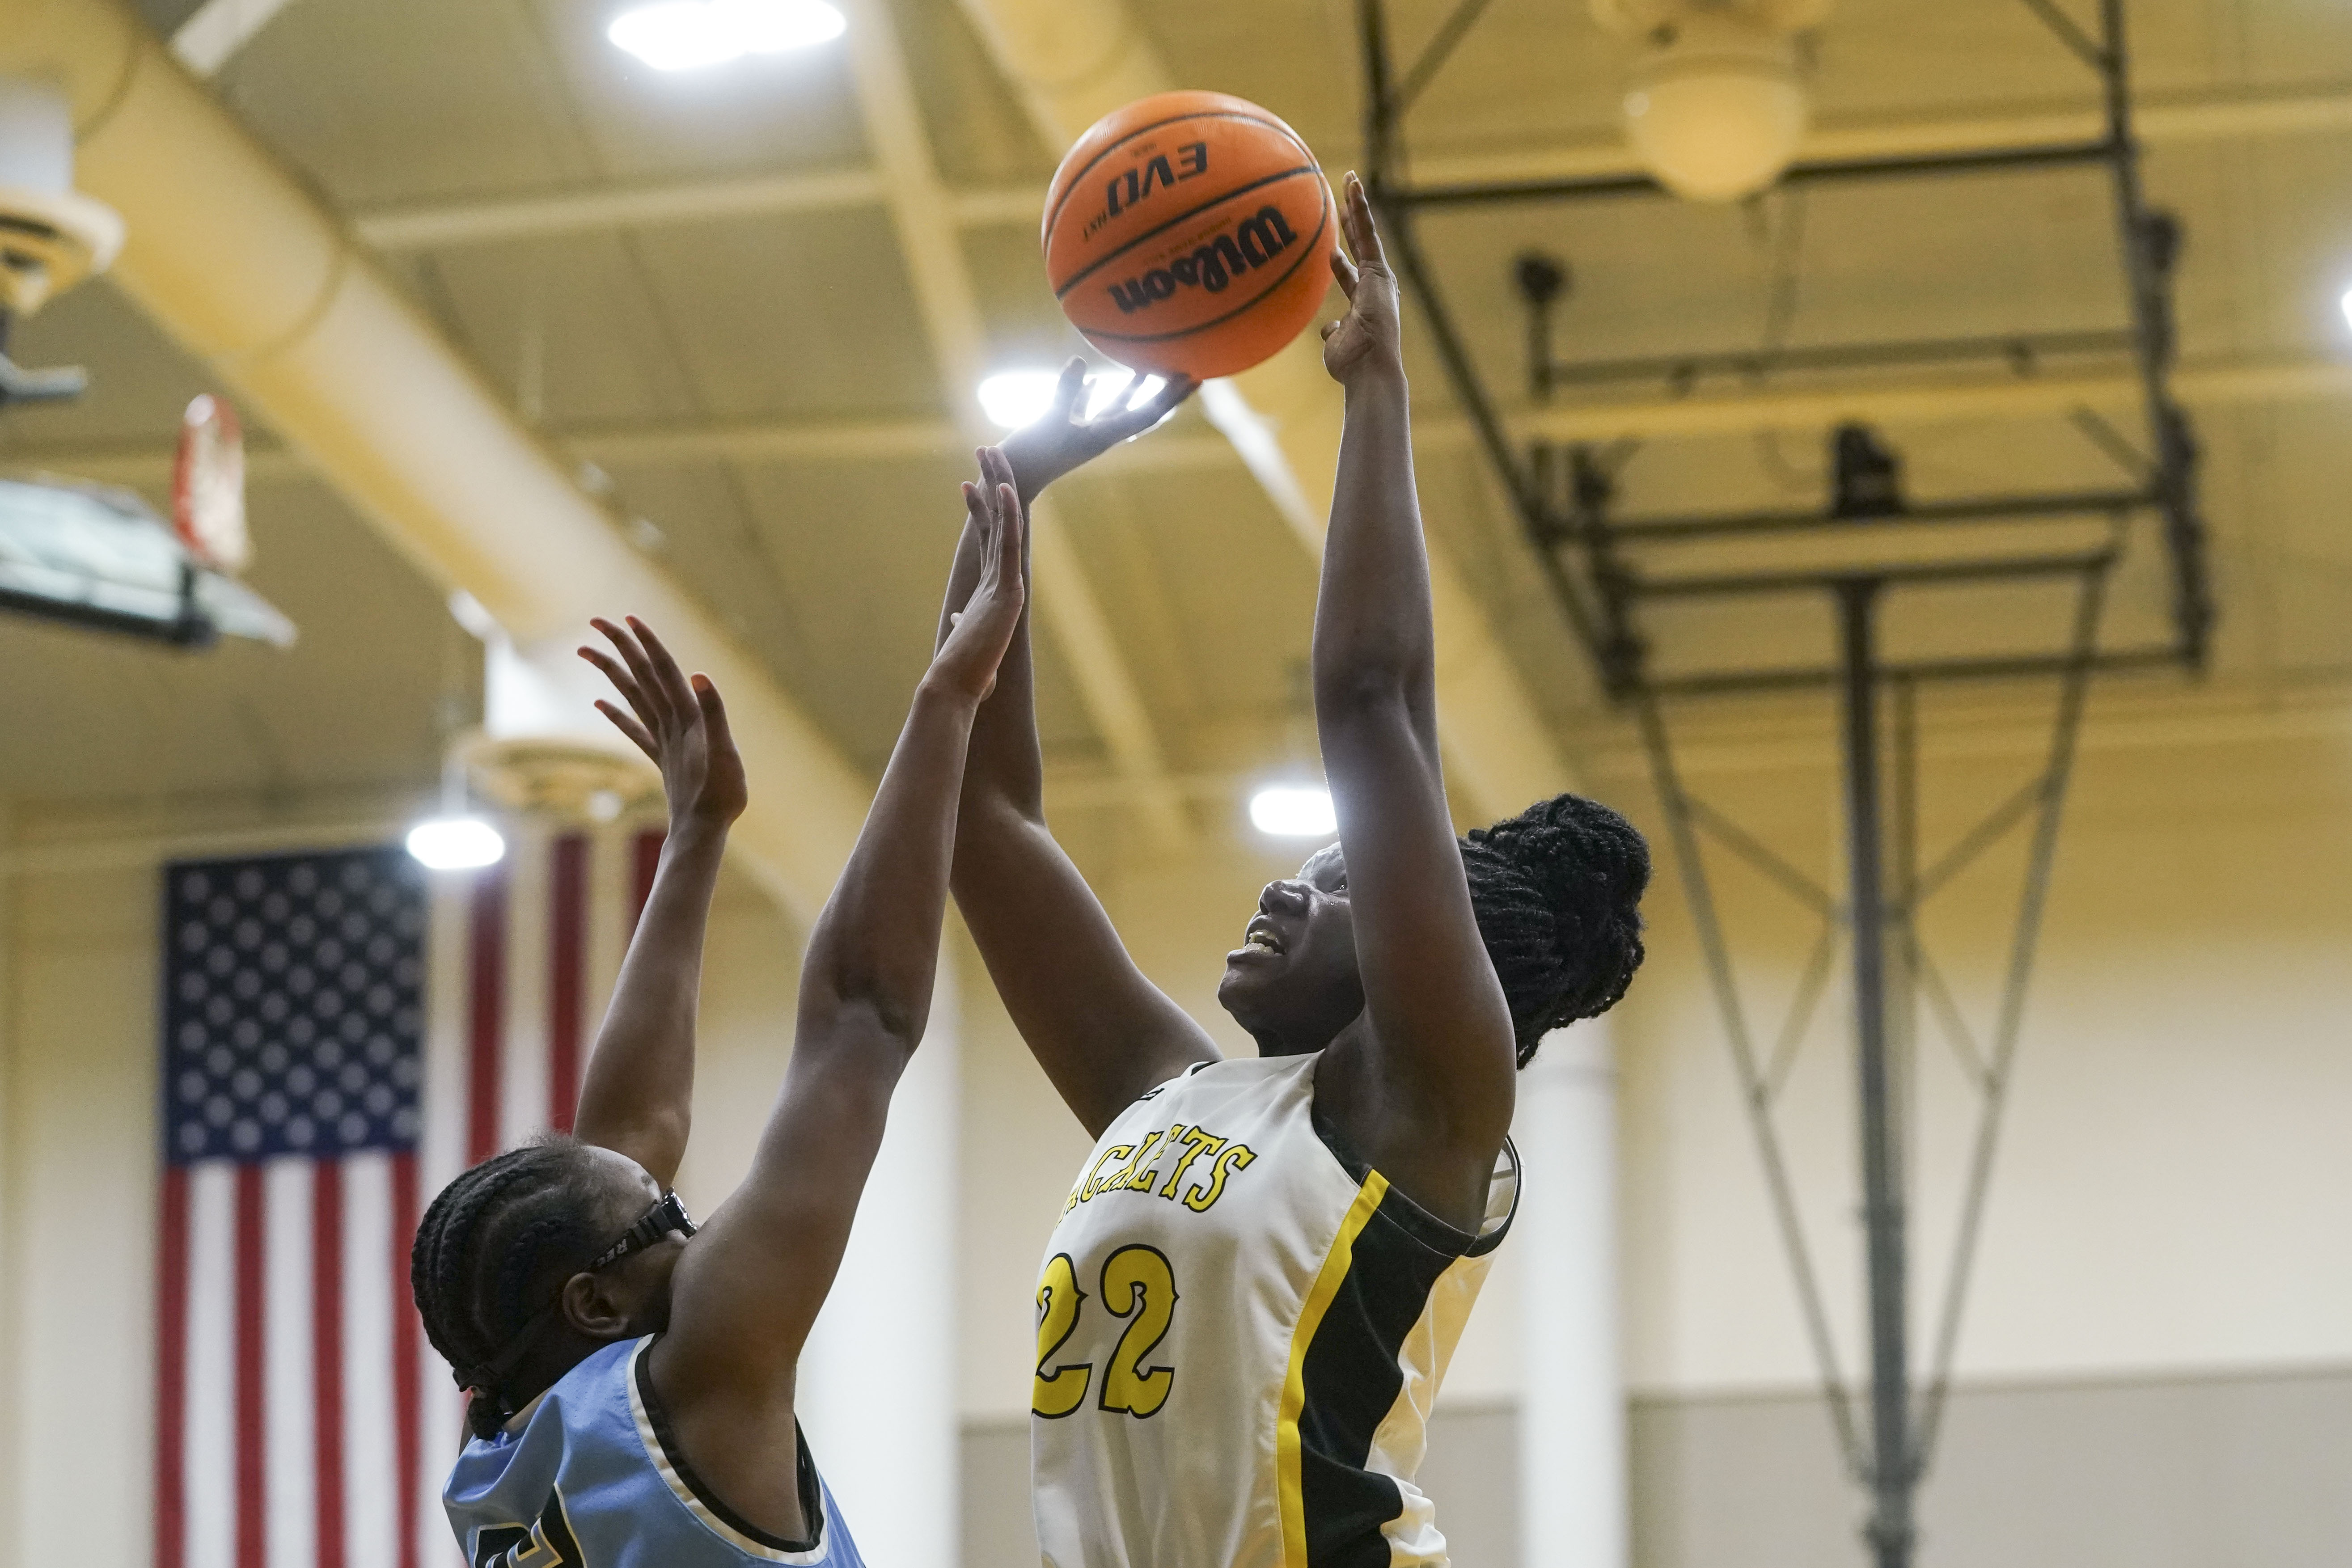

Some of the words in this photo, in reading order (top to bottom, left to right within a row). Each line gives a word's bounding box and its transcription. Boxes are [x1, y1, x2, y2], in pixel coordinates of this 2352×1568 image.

[1107, 141, 1207, 218] EVO
[1108, 205, 1297, 314] Wilson
[1032, 1243, 1180, 1420] 22
